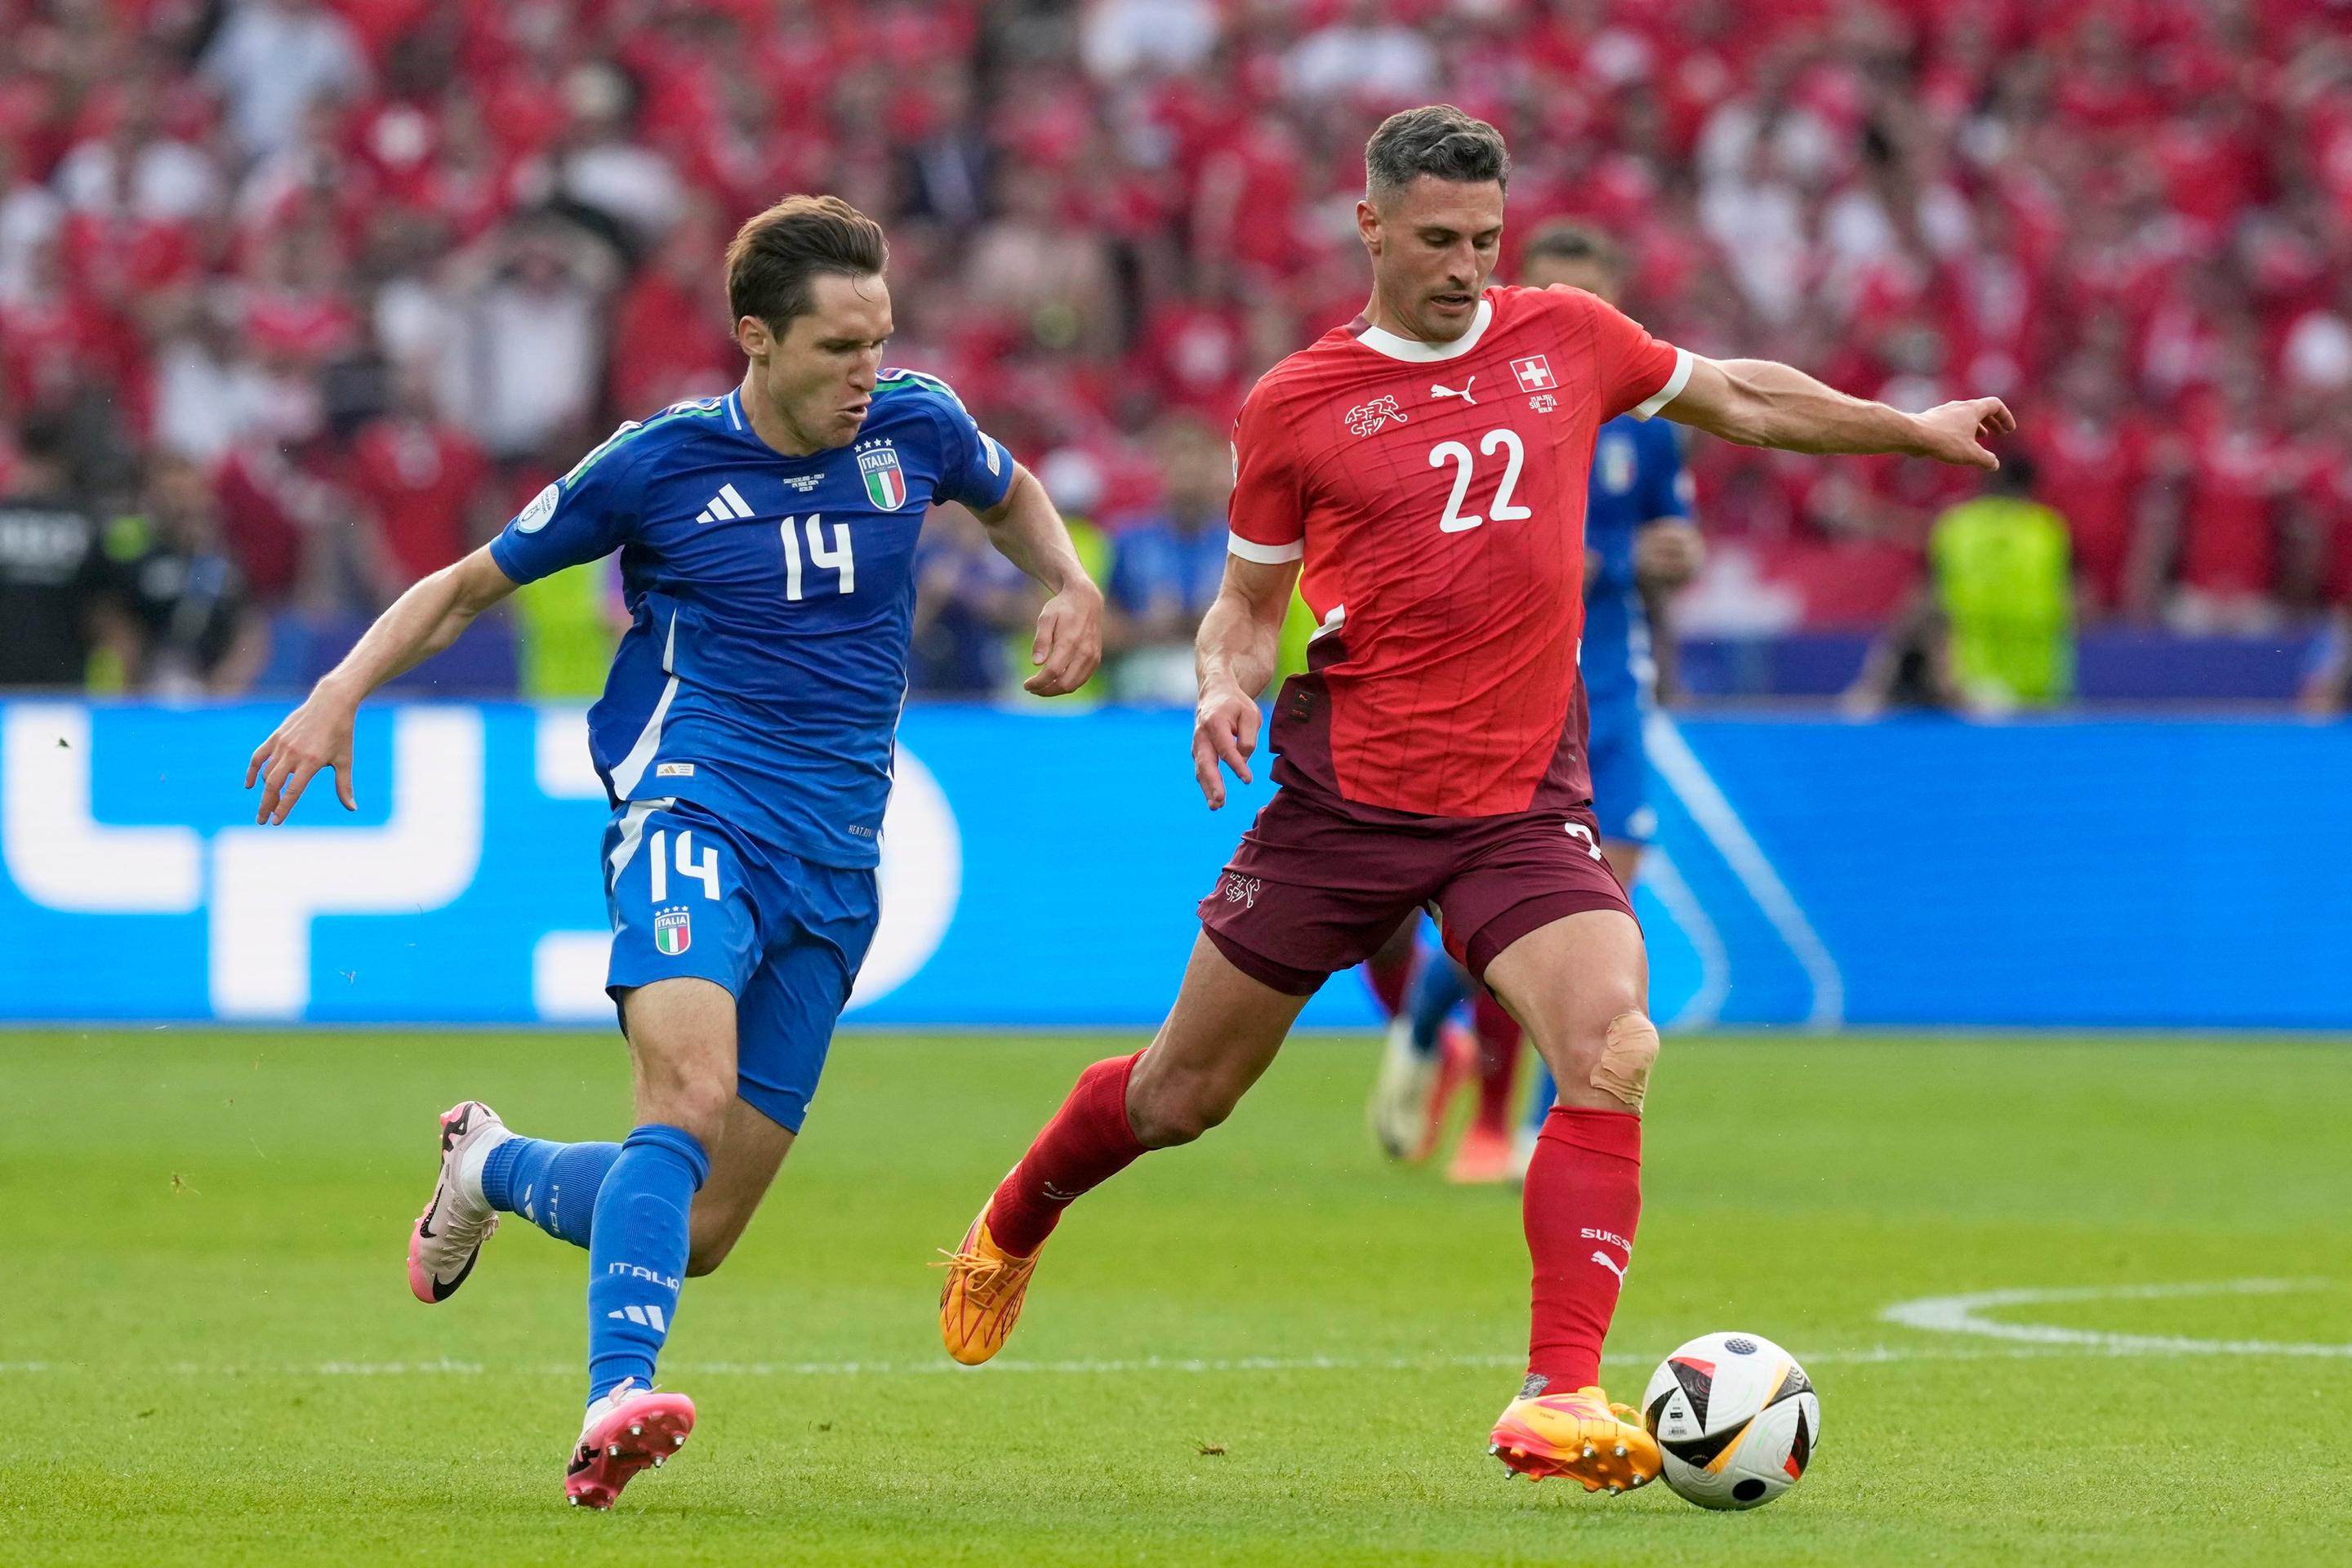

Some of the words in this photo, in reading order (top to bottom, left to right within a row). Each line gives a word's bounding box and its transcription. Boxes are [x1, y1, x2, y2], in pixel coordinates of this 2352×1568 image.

[1529, 400, 1541, 409] SUI
[861, 453, 896, 470] ITALIA
[1428, 429, 1532, 533] 22
[780, 513, 855, 601] 14
[650, 830, 720, 903] 14
[657, 915, 687, 928] ITALIA
[1580, 1227, 1633, 1258] SUISS
[608, 1263, 679, 1293] ITALIA
